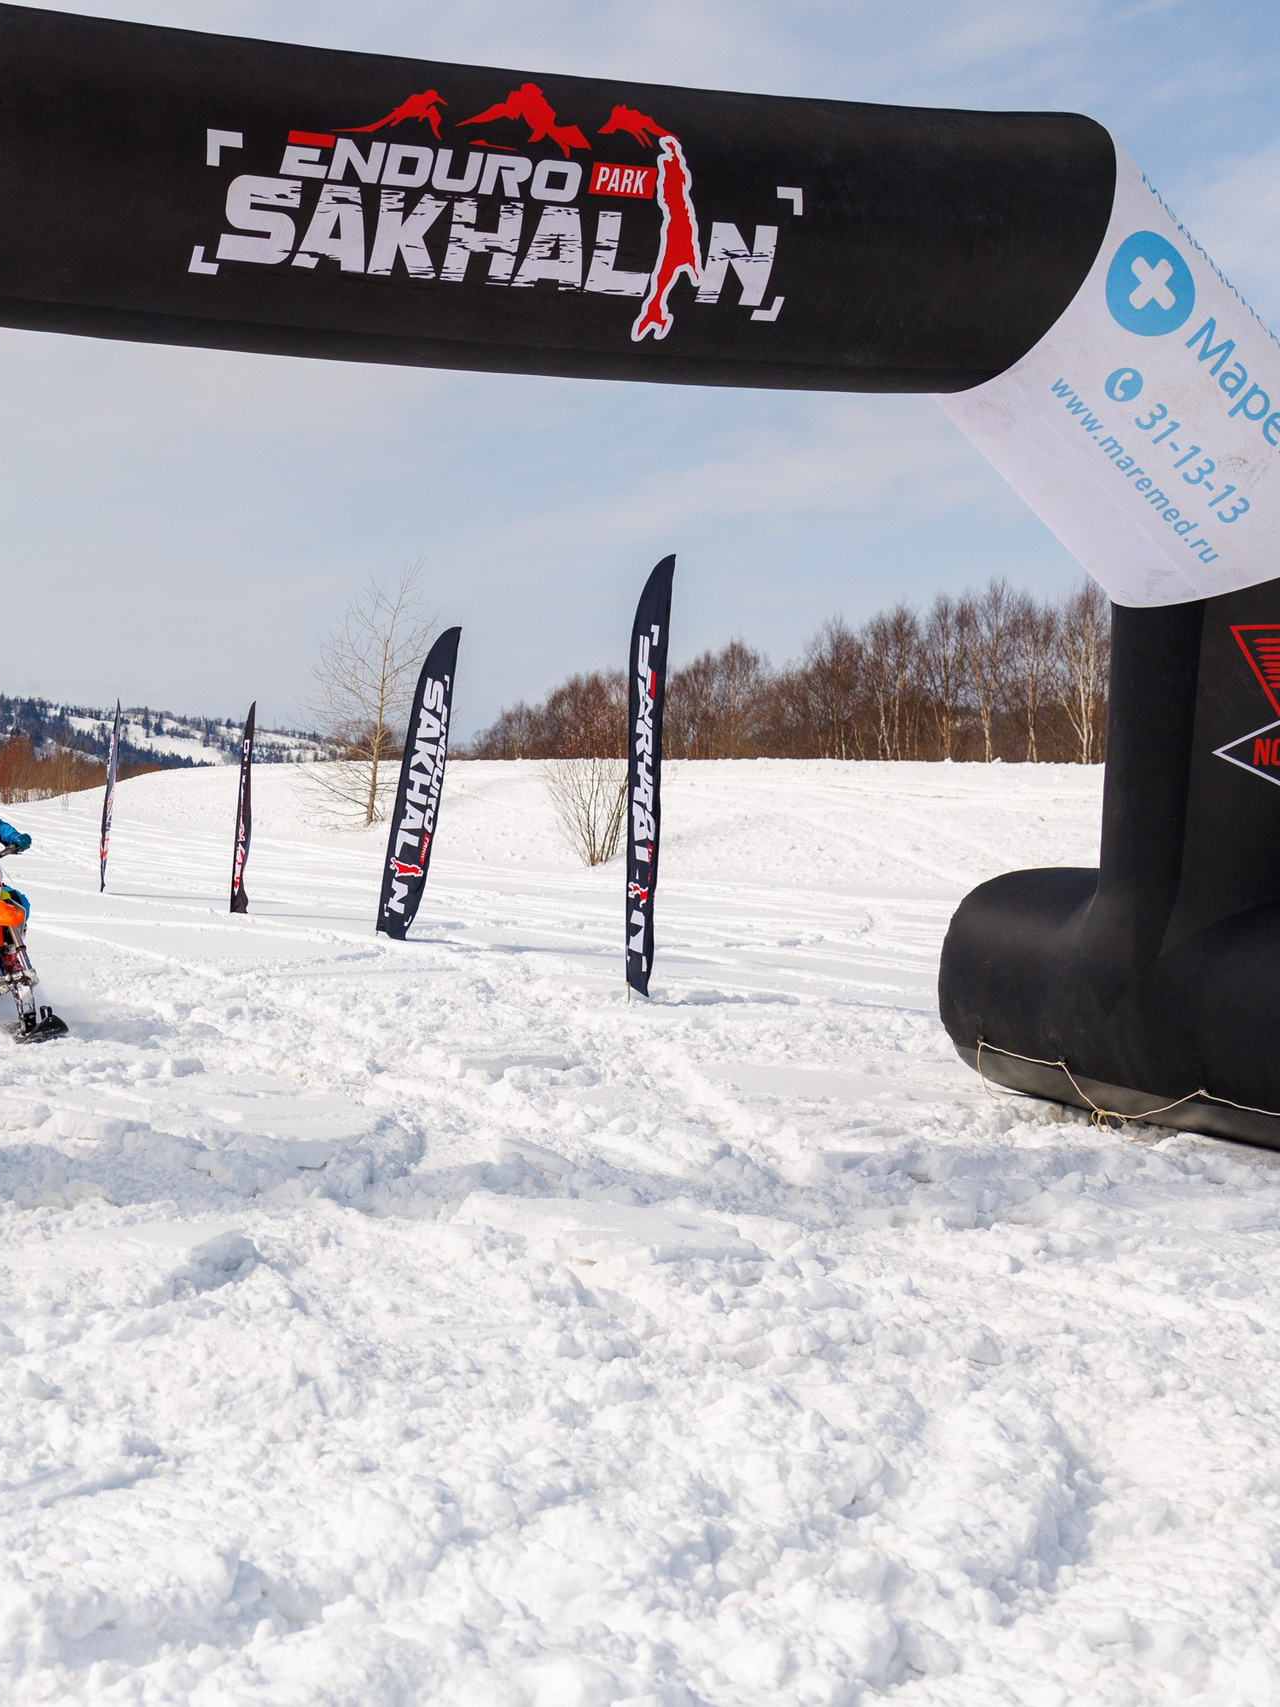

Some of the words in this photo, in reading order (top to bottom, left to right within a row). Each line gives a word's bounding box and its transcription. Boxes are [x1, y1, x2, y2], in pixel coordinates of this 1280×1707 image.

[279, 130, 583, 204] ENDURO
[595, 164, 649, 196] PARK
[1185, 316, 1280, 455] Маре
[1050, 377, 1219, 565] www.maremed.ru
[1134, 403, 1251, 524] 31-13-13
